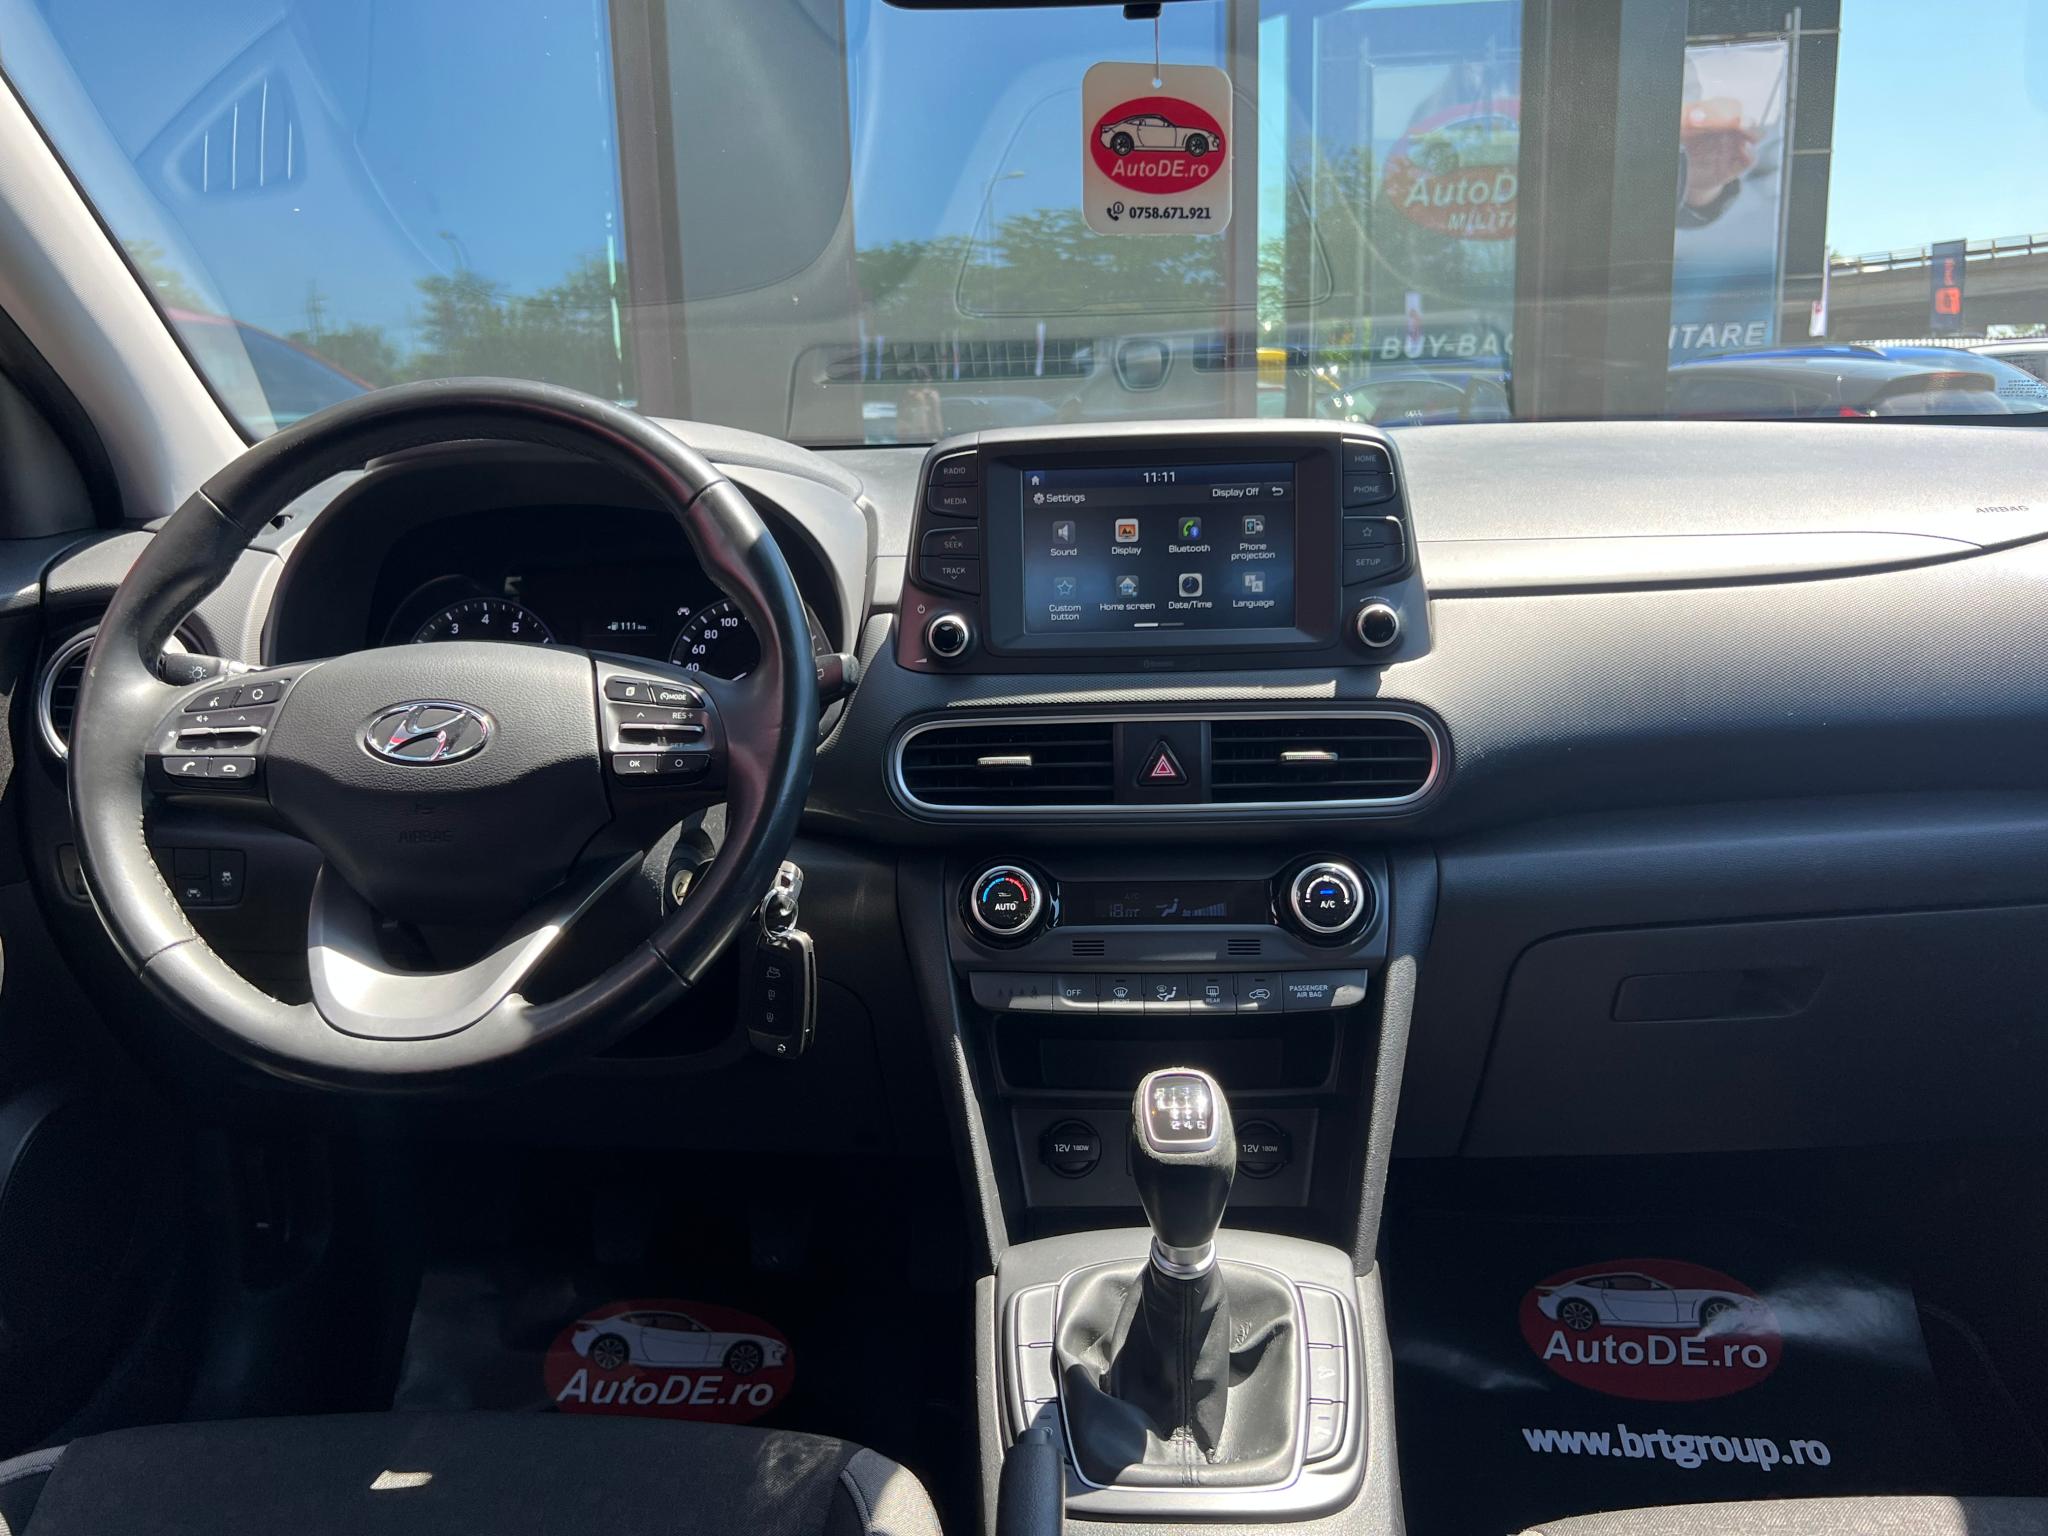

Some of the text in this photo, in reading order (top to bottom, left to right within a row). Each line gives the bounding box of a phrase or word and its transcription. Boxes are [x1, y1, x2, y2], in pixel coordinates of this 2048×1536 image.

[1112, 160, 1209, 178] AutoDE.ro
[1129, 207, 1211, 220] 0758.671.921
[1354, 454, 1377, 463] HOME
[943, 467, 966, 475] RADIO
[1143, 472, 1176, 483] 11:11
[1212, 487, 1259, 498] Display Off
[1353, 485, 1380, 494] PHONE
[943, 497, 968, 505] MEDIA
[1046, 493, 1086, 503] Settings
[1976, 505, 2030, 513] AIRBAG
[943, 541, 963, 549] SEEK
[1168, 543, 1211, 553] Bluetooth
[1239, 542, 1267, 551] Phone
[1050, 548, 1078, 556] Sound
[1111, 546, 1142, 556] Display
[1231, 552, 1276, 561] projection
[1355, 558, 1381, 566] SETUP
[942, 567, 966, 575] TRACK
[1100, 602, 1156, 611] Home screen
[1168, 600, 1213, 610] Date/Time
[1232, 598, 1275, 608] Language
[1048, 603, 1082, 613] Custom
[481, 614, 489, 625] 4
[1050, 612, 1080, 621] button
[620, 622, 637, 631] 111
[720, 618, 738, 627] 100
[451, 623, 459, 634] 3
[511, 622, 520, 633] 5
[704, 629, 718, 639] 80
[691, 644, 706, 655] 60
[685, 662, 700, 672] 40
[672, 712, 687, 720] RES
[629, 760, 641, 768] OK
[995, 903, 1017, 911] AUTO
[1320, 900, 1336, 909] A/C
[1066, 988, 1082, 997] OFF
[1289, 984, 1329, 993] PASSENGER
[1309, 990, 1323, 998] BAG
[1053, 1143, 1071, 1152] 12V
[1242, 1143, 1260, 1153] 12V
[1543, 1330, 1769, 1369] AutoDE.ro
[556, 1367, 776, 1407] AutoDE.ro
[1521, 1424, 1832, 1472] www.brtgroup.ro
